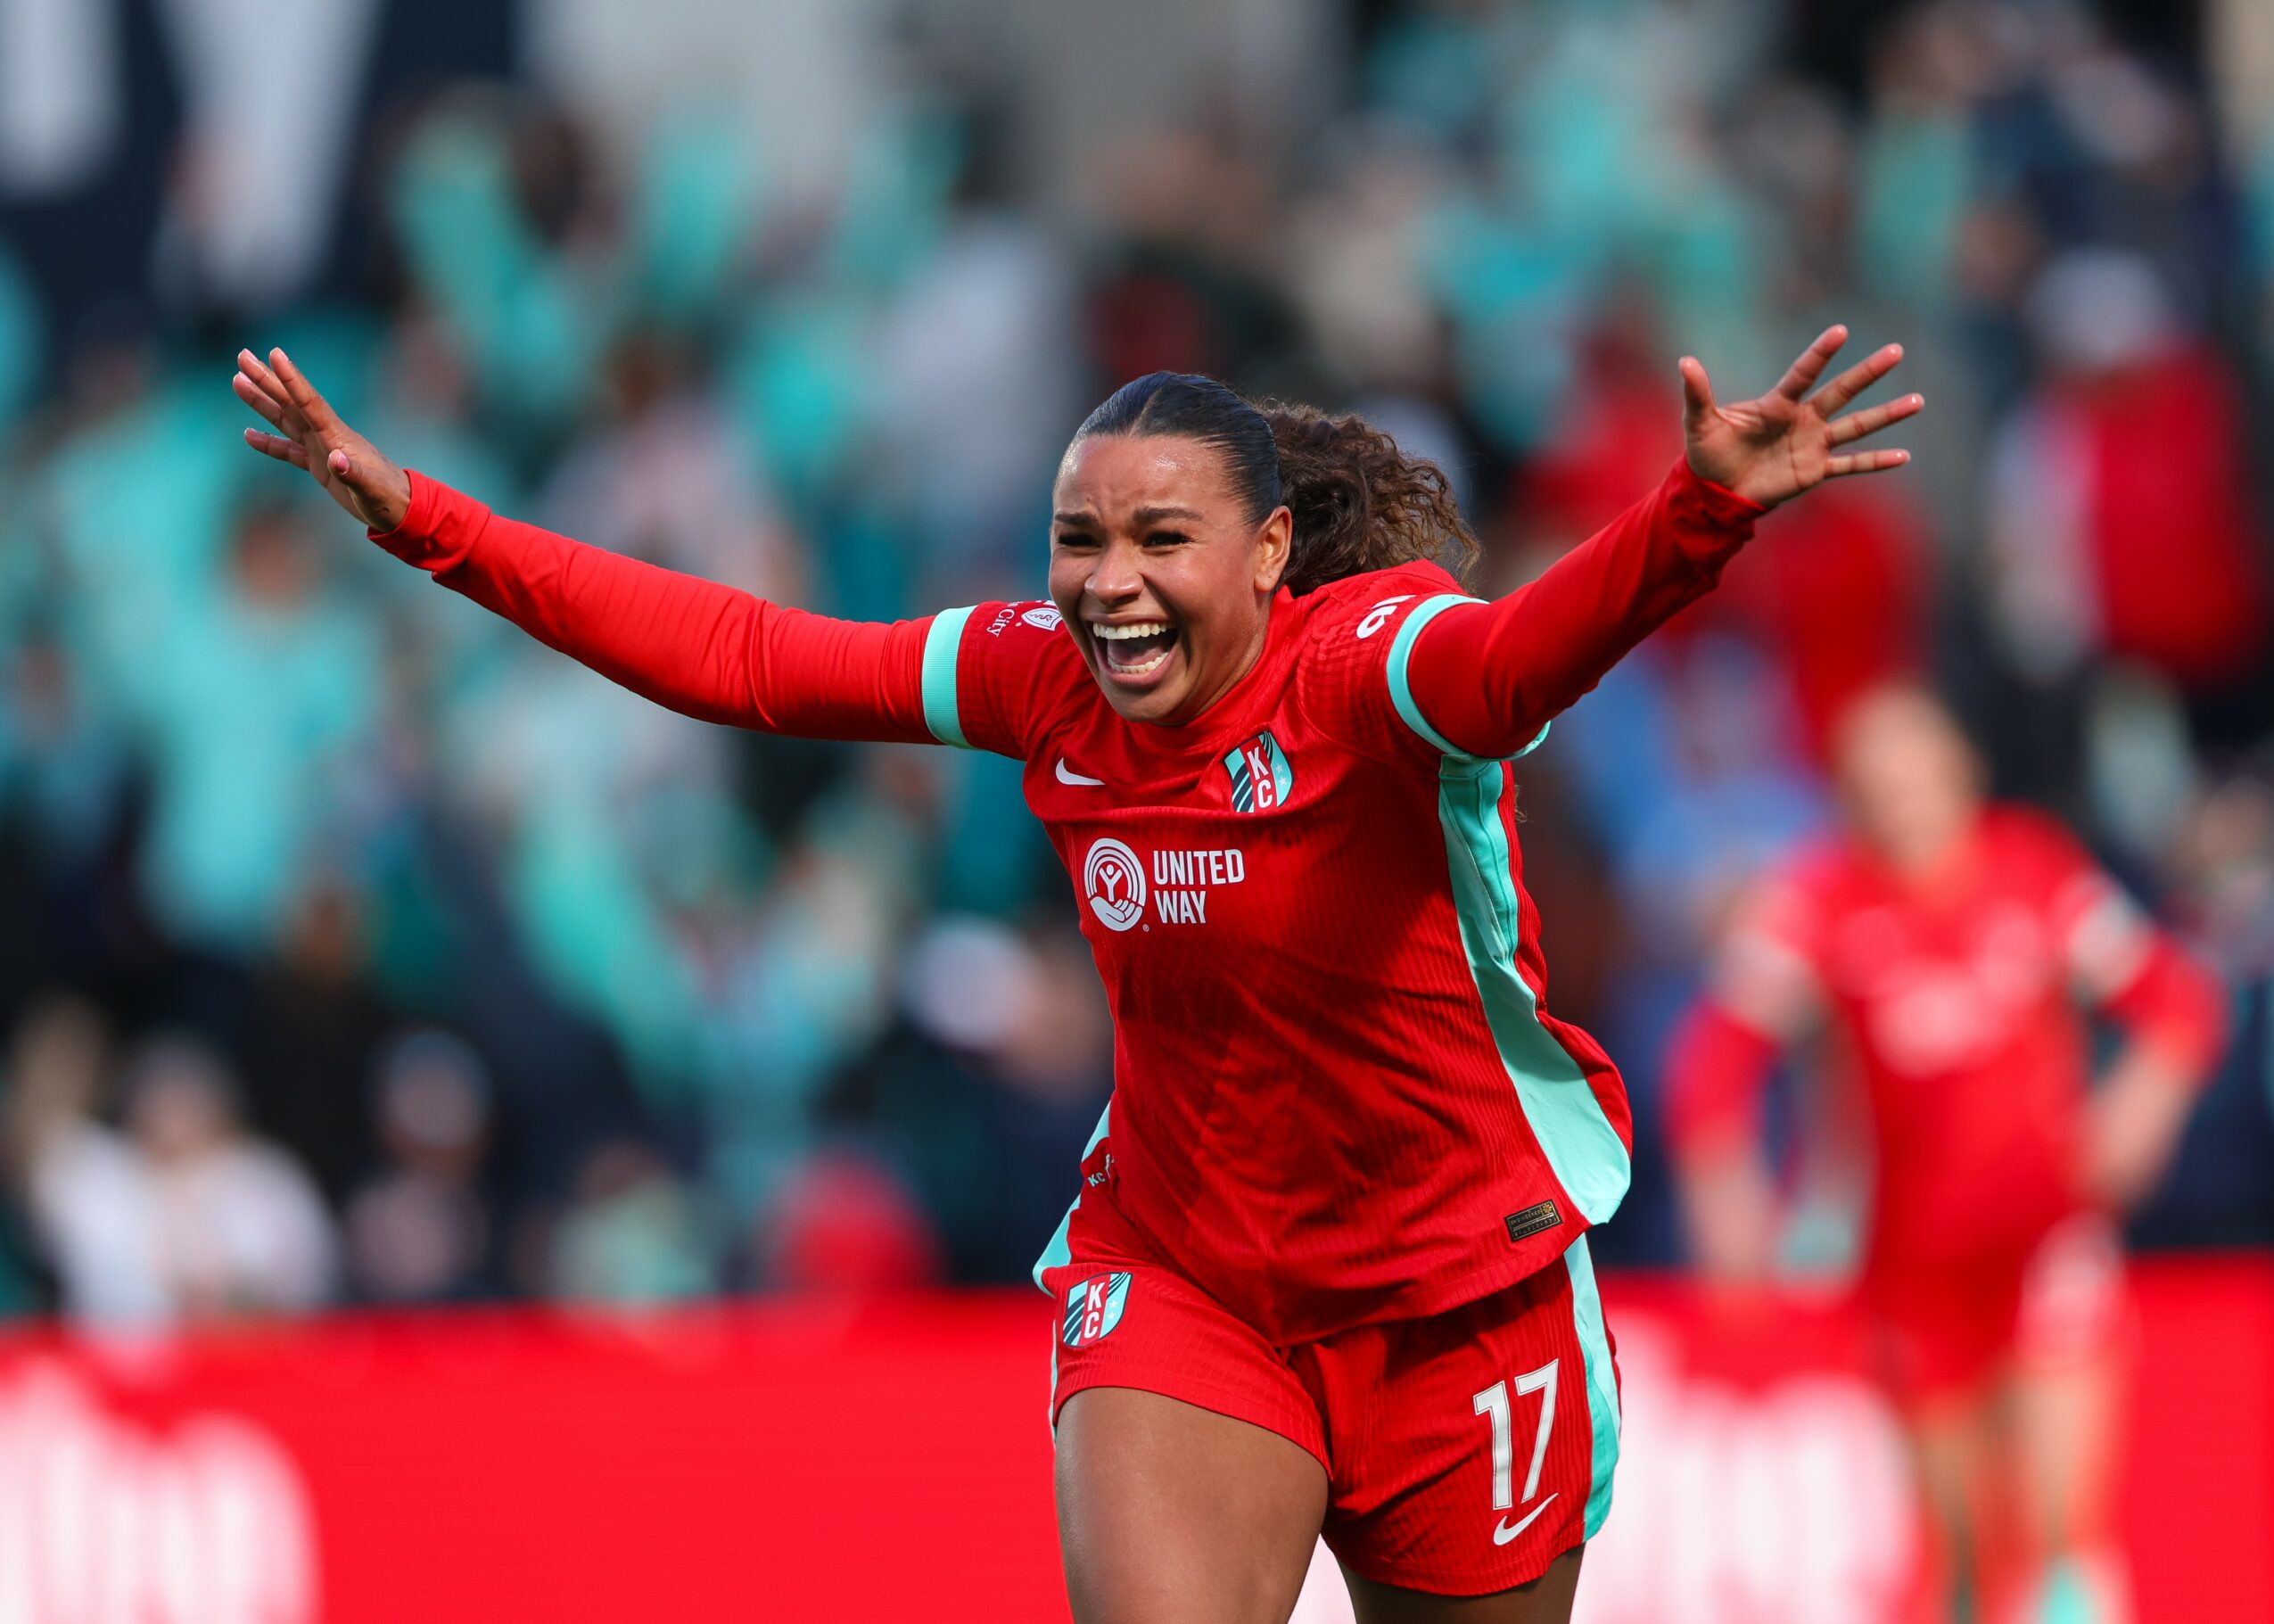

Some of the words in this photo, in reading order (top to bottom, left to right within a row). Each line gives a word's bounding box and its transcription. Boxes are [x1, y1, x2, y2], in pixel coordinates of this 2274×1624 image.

[986, 608, 1015, 638] City
[1153, 848, 1245, 886] UNITED
[1154, 890, 1207, 924] WAY
[1472, 1357, 1559, 1511] 17
